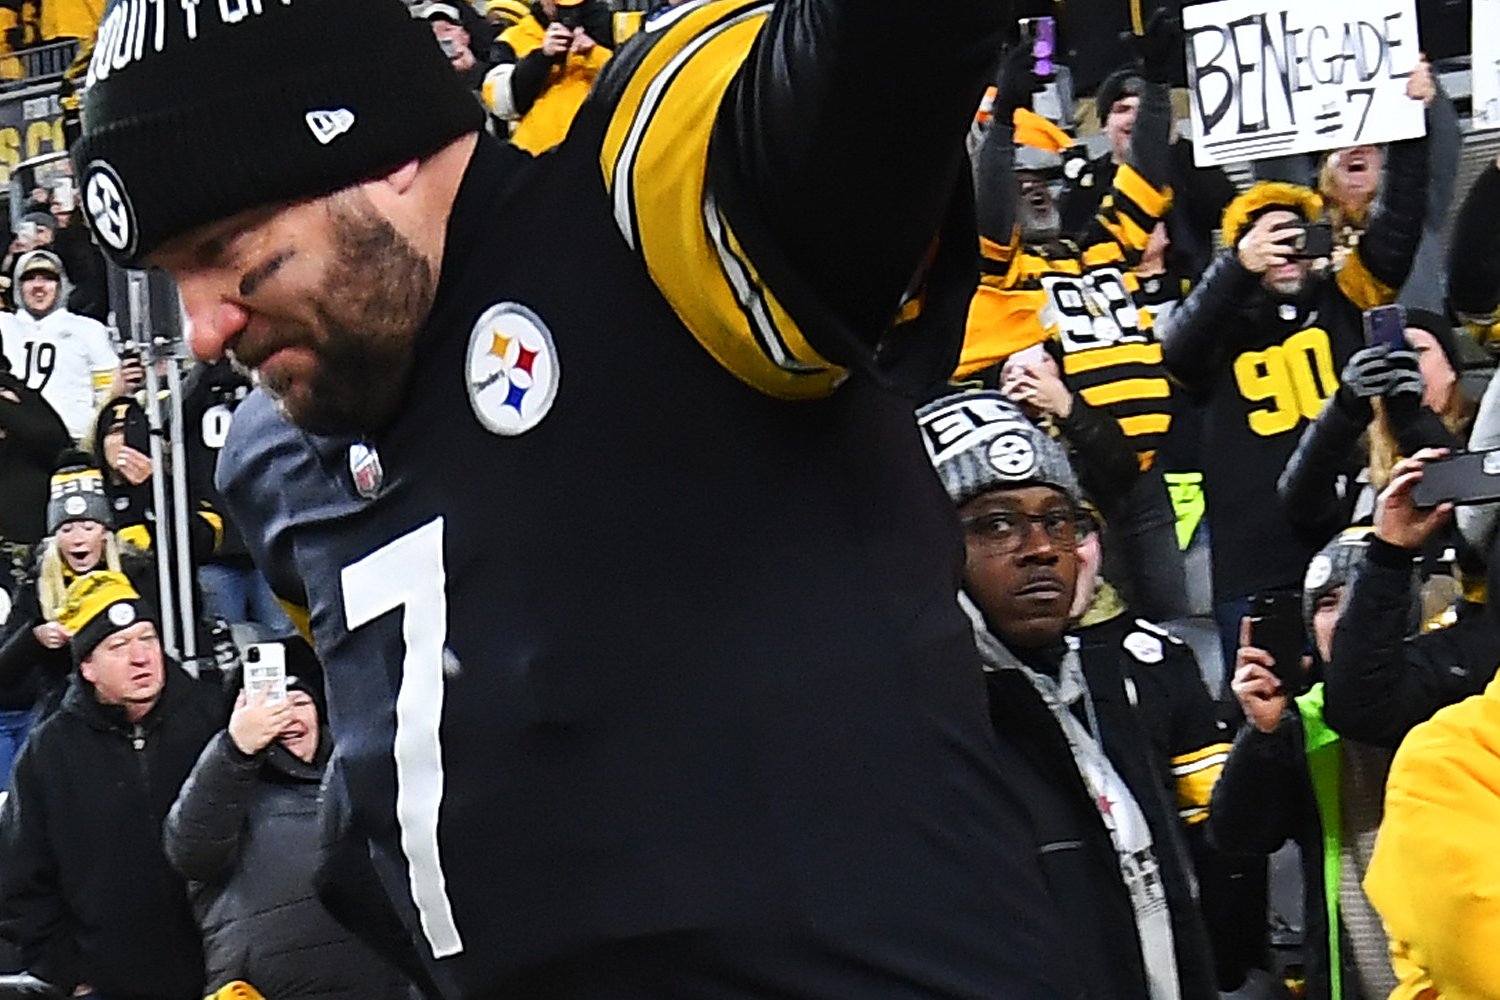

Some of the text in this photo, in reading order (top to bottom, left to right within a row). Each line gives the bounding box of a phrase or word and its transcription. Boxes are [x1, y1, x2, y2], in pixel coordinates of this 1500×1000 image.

[24, 341, 57, 392] 19
[1233, 327, 1340, 437] 90
[341, 513, 464, 960] 7
